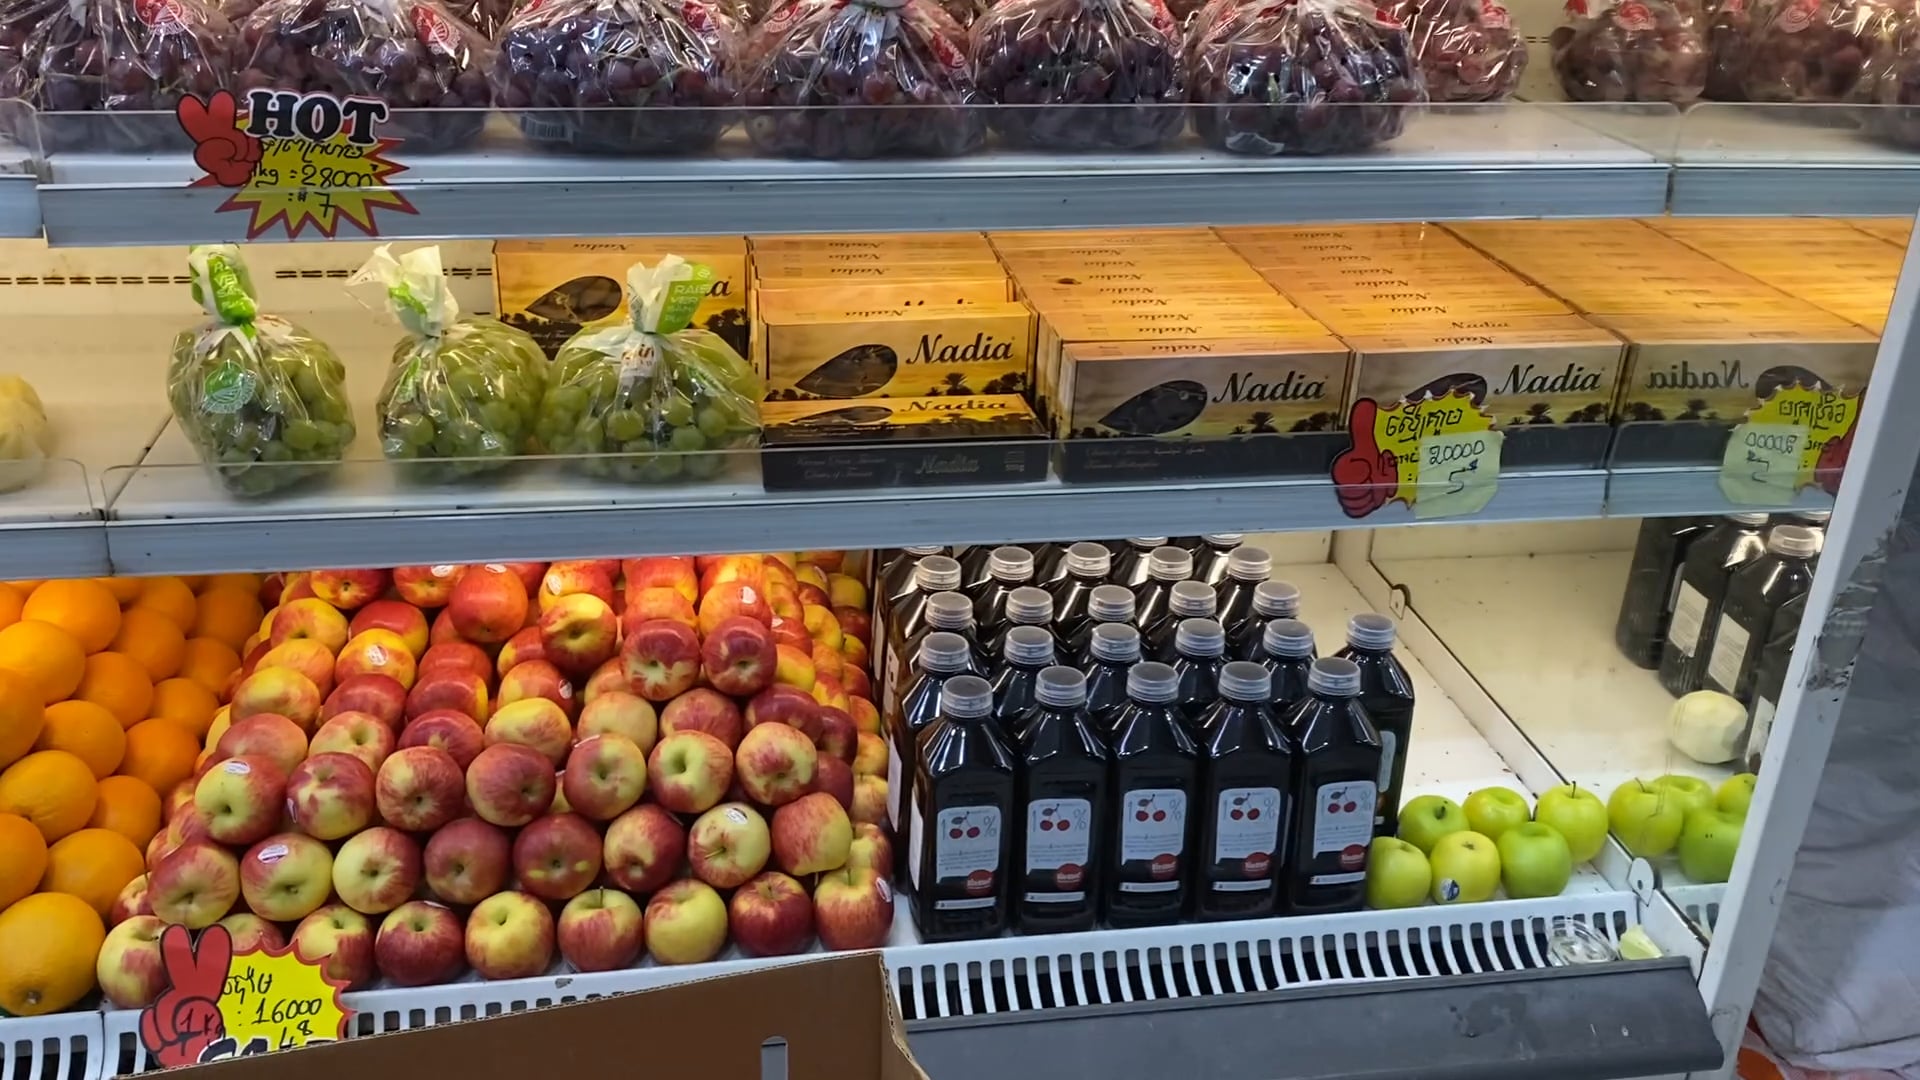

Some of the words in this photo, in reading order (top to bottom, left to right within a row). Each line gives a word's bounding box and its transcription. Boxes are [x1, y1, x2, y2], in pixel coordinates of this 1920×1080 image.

[248, 90, 387, 143] HOT
[905, 332, 1014, 365] Nadia
[1212, 371, 1326, 403] Nadia
[1494, 363, 1602, 394] Nadia
[900, 400, 1008, 412] Nadia
[1429, 440, 1485, 465] 20000
[251, 998, 322, 1024] 16000
